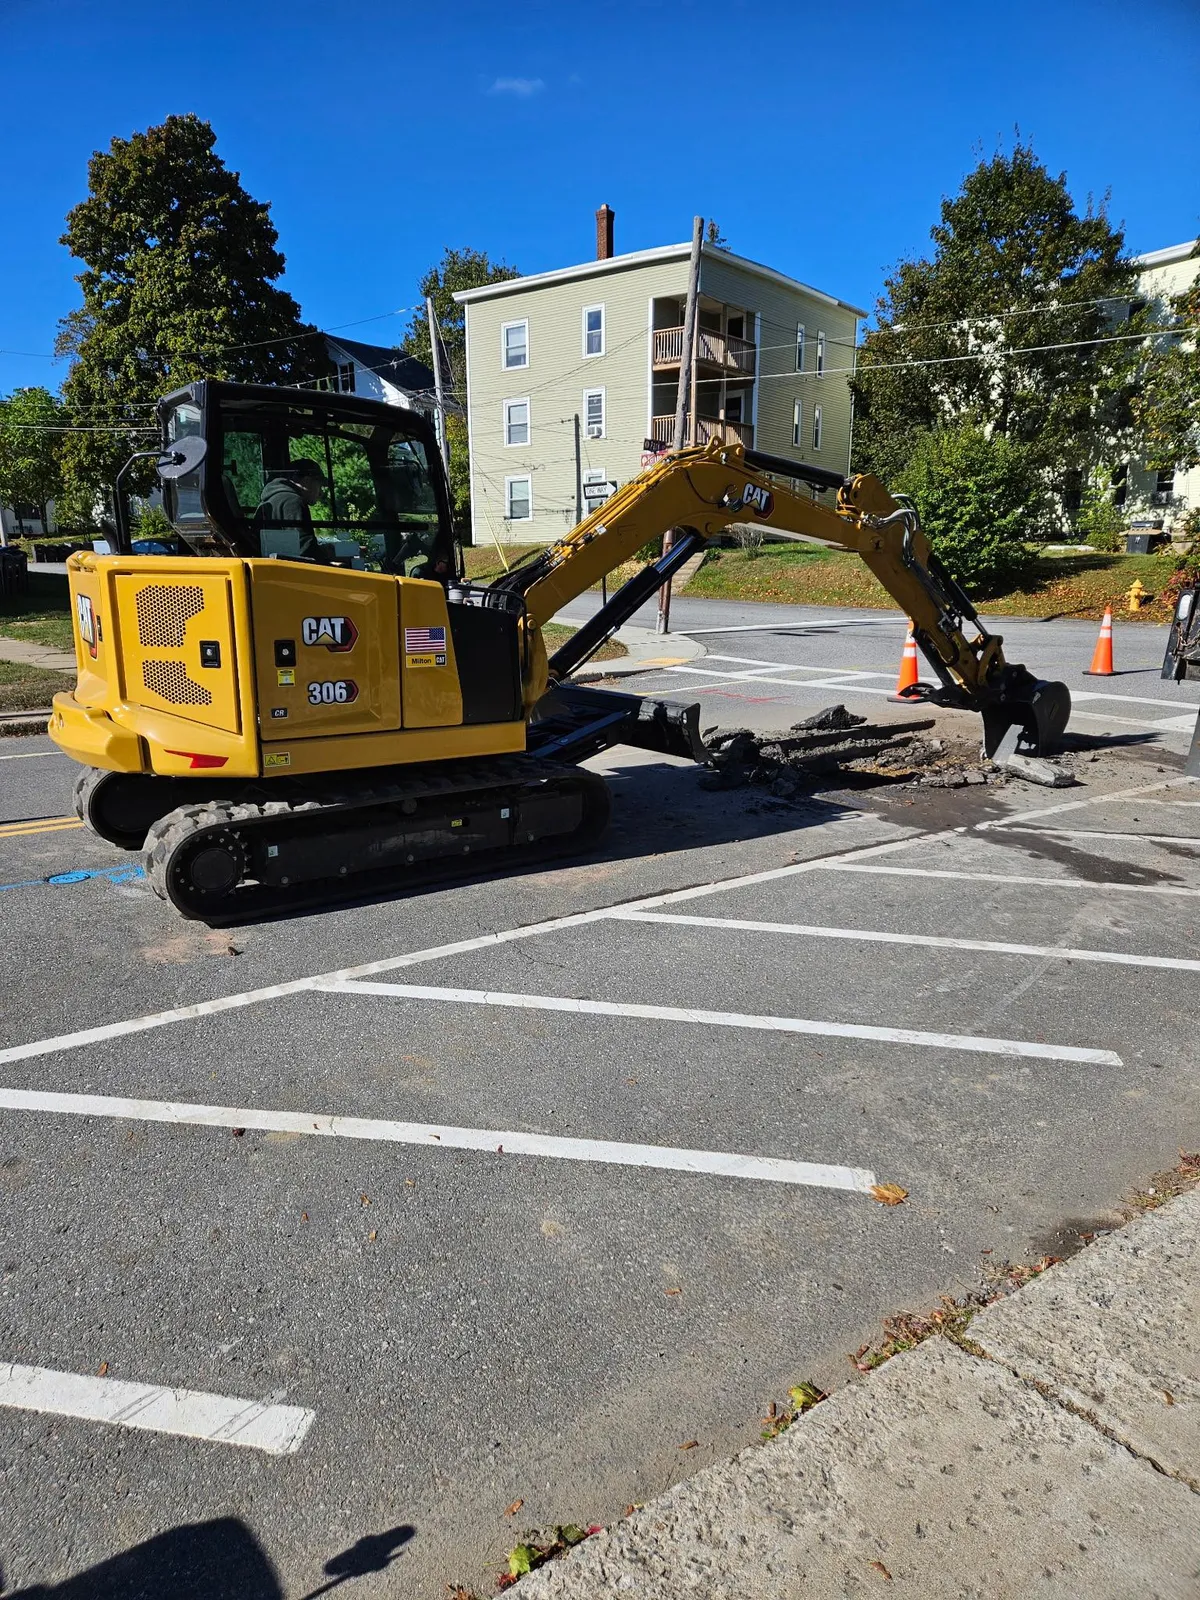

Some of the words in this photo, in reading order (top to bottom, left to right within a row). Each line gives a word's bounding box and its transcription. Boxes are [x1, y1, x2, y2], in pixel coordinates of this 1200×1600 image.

[586, 487, 596, 495] ONE
[743, 483, 770, 511] CAT
[77, 594, 94, 643] CAT
[302, 618, 345, 645] CAT
[436, 656, 445, 664] CAT
[308, 681, 347, 704] 306
[274, 709, 285, 717] CR
